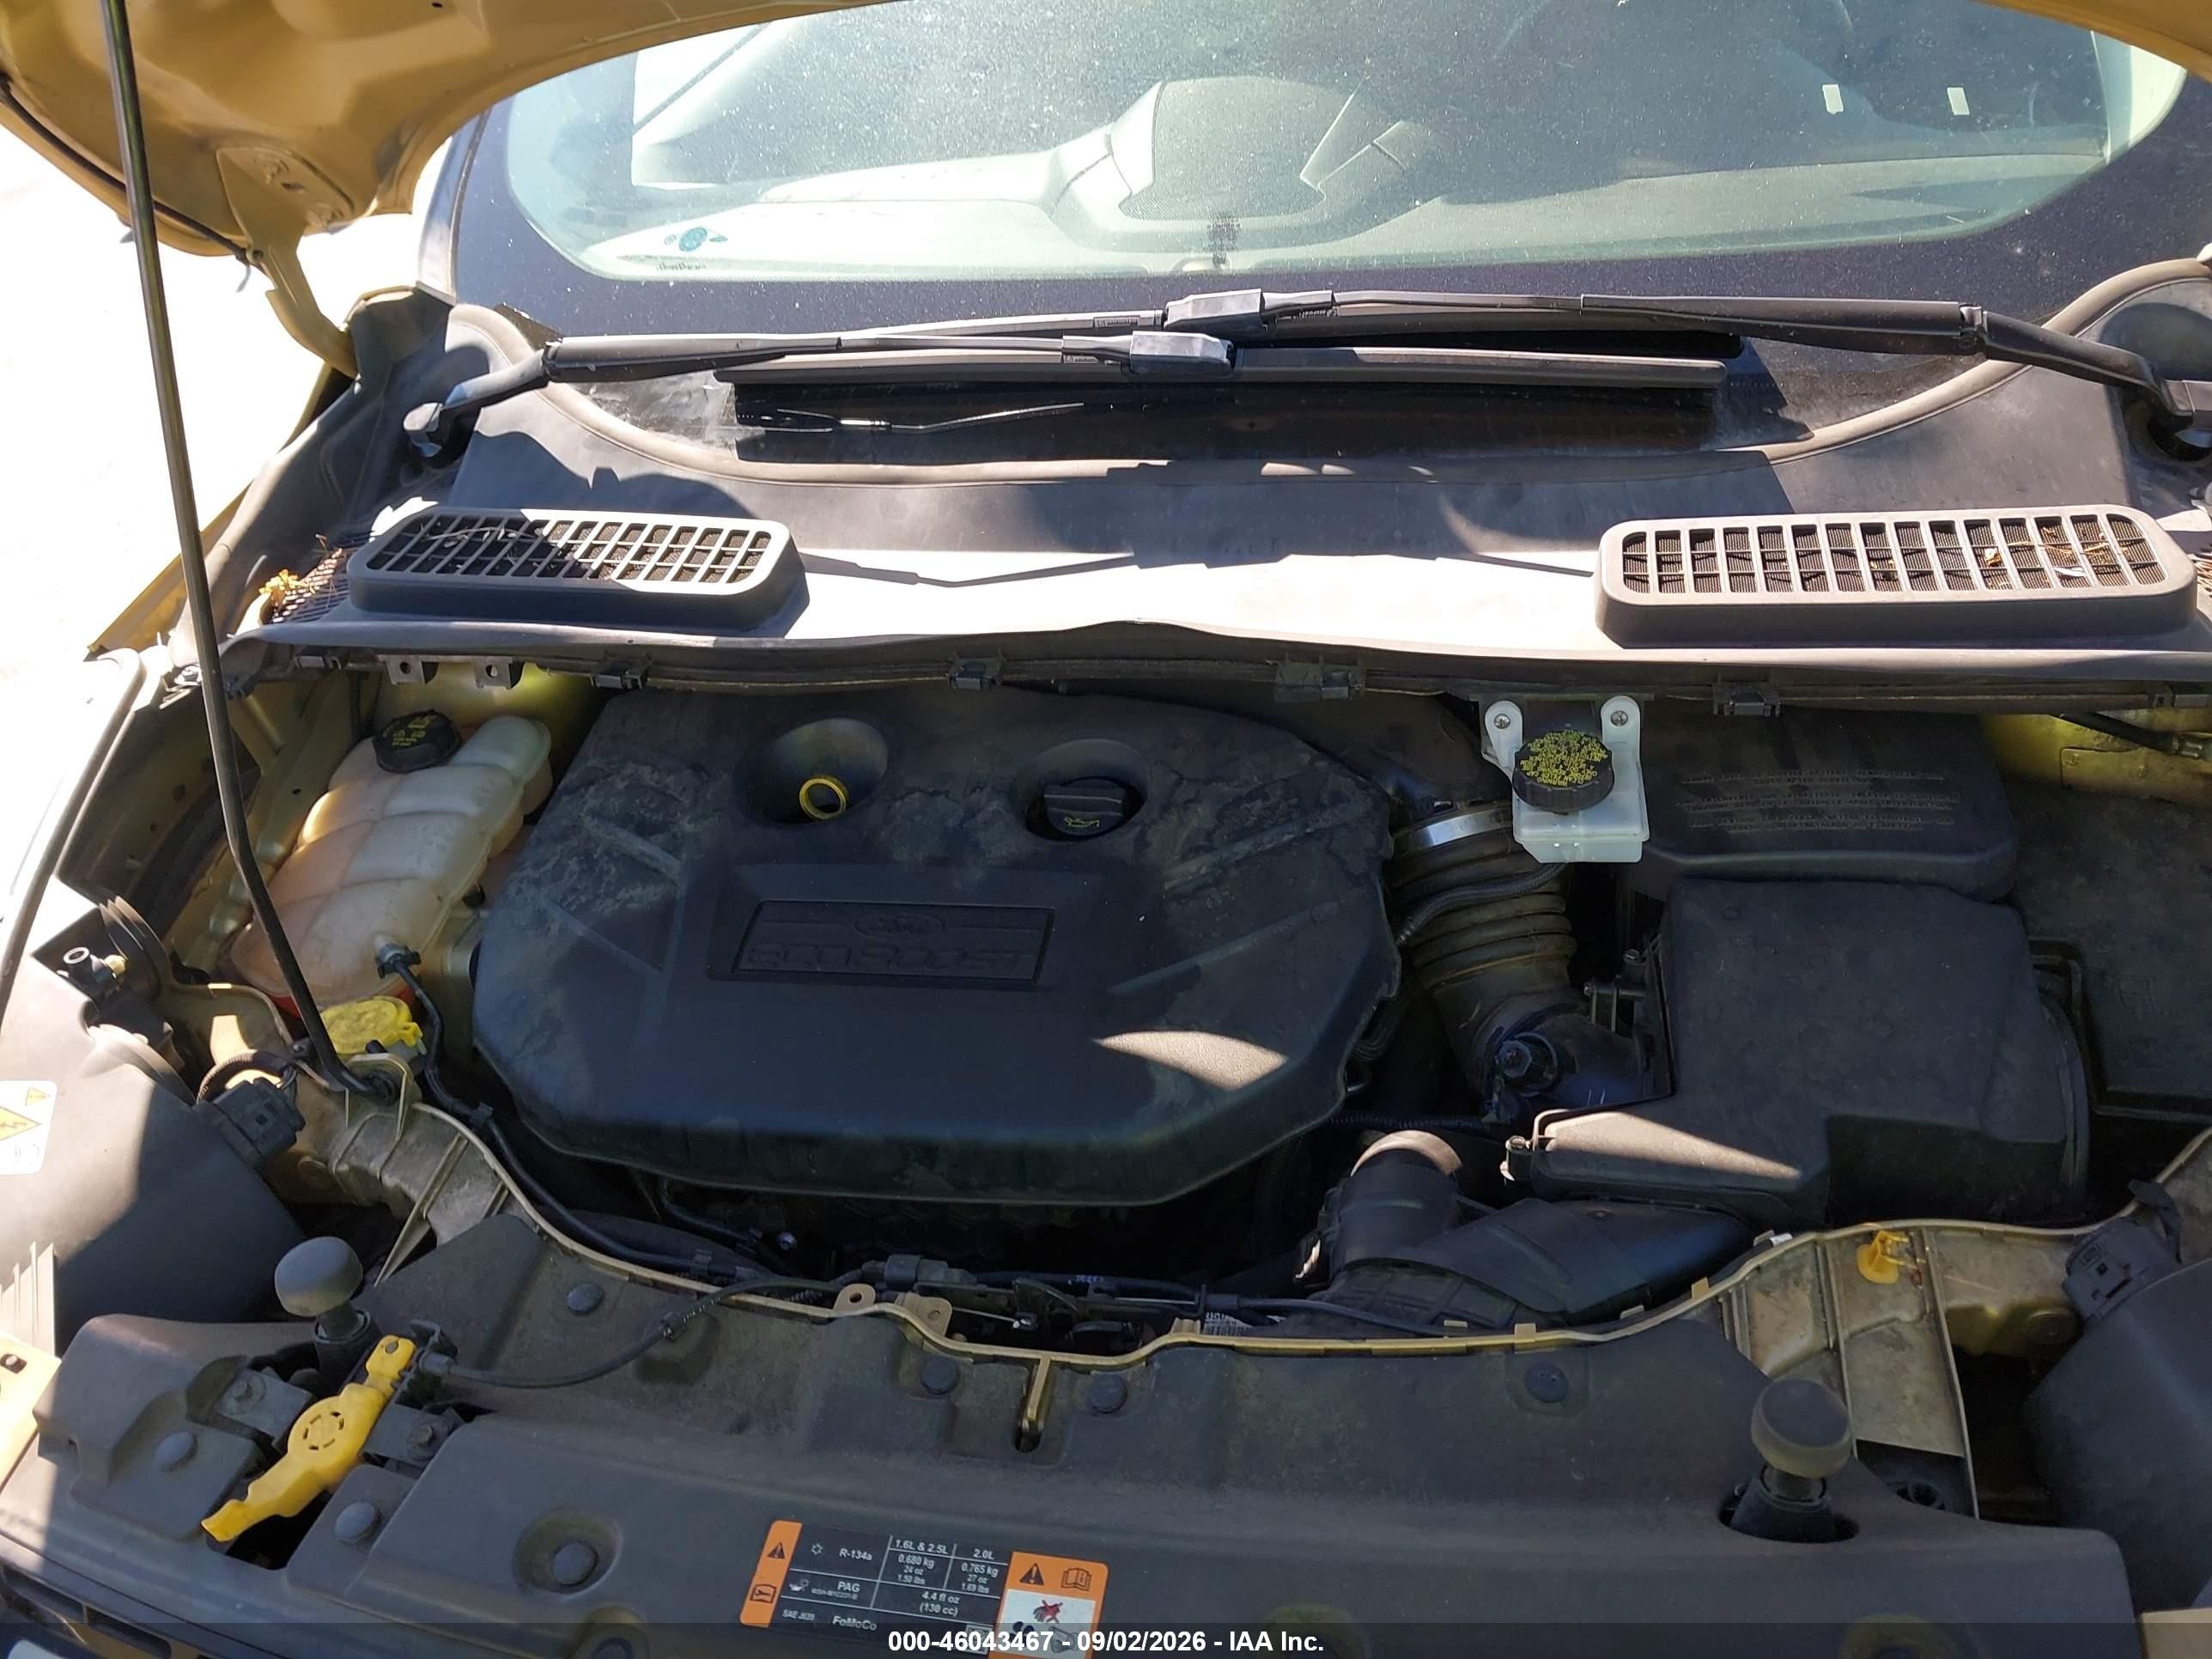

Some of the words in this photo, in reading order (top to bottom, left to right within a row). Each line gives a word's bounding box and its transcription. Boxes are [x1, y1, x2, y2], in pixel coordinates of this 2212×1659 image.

[896, 1540, 915, 1550] 1.6L
[917, 1542, 925, 1551] &
[927, 1544, 948, 1554] 2.5L
[839, 1548, 872, 1561] R-134a
[973, 1548, 994, 1559] 2.0L
[923, 1557, 934, 1569] kg
[903, 1565, 913, 1574] 24
[961, 1563, 985, 1574] 0.765
[987, 1565, 999, 1578] kg
[913, 1576, 925, 1585] lbs
[966, 1574, 976, 1583] 27
[837, 1581, 860, 1592] PAG
[977, 1584, 989, 1594] lbs
[921, 1590, 937, 1601] 4.4
[948, 1595, 960, 1604] oz
[783, 1608, 798, 1619] SAE
[942, 1605, 958, 1617] cc)
[832, 1615, 877, 1631] FoMoCo
